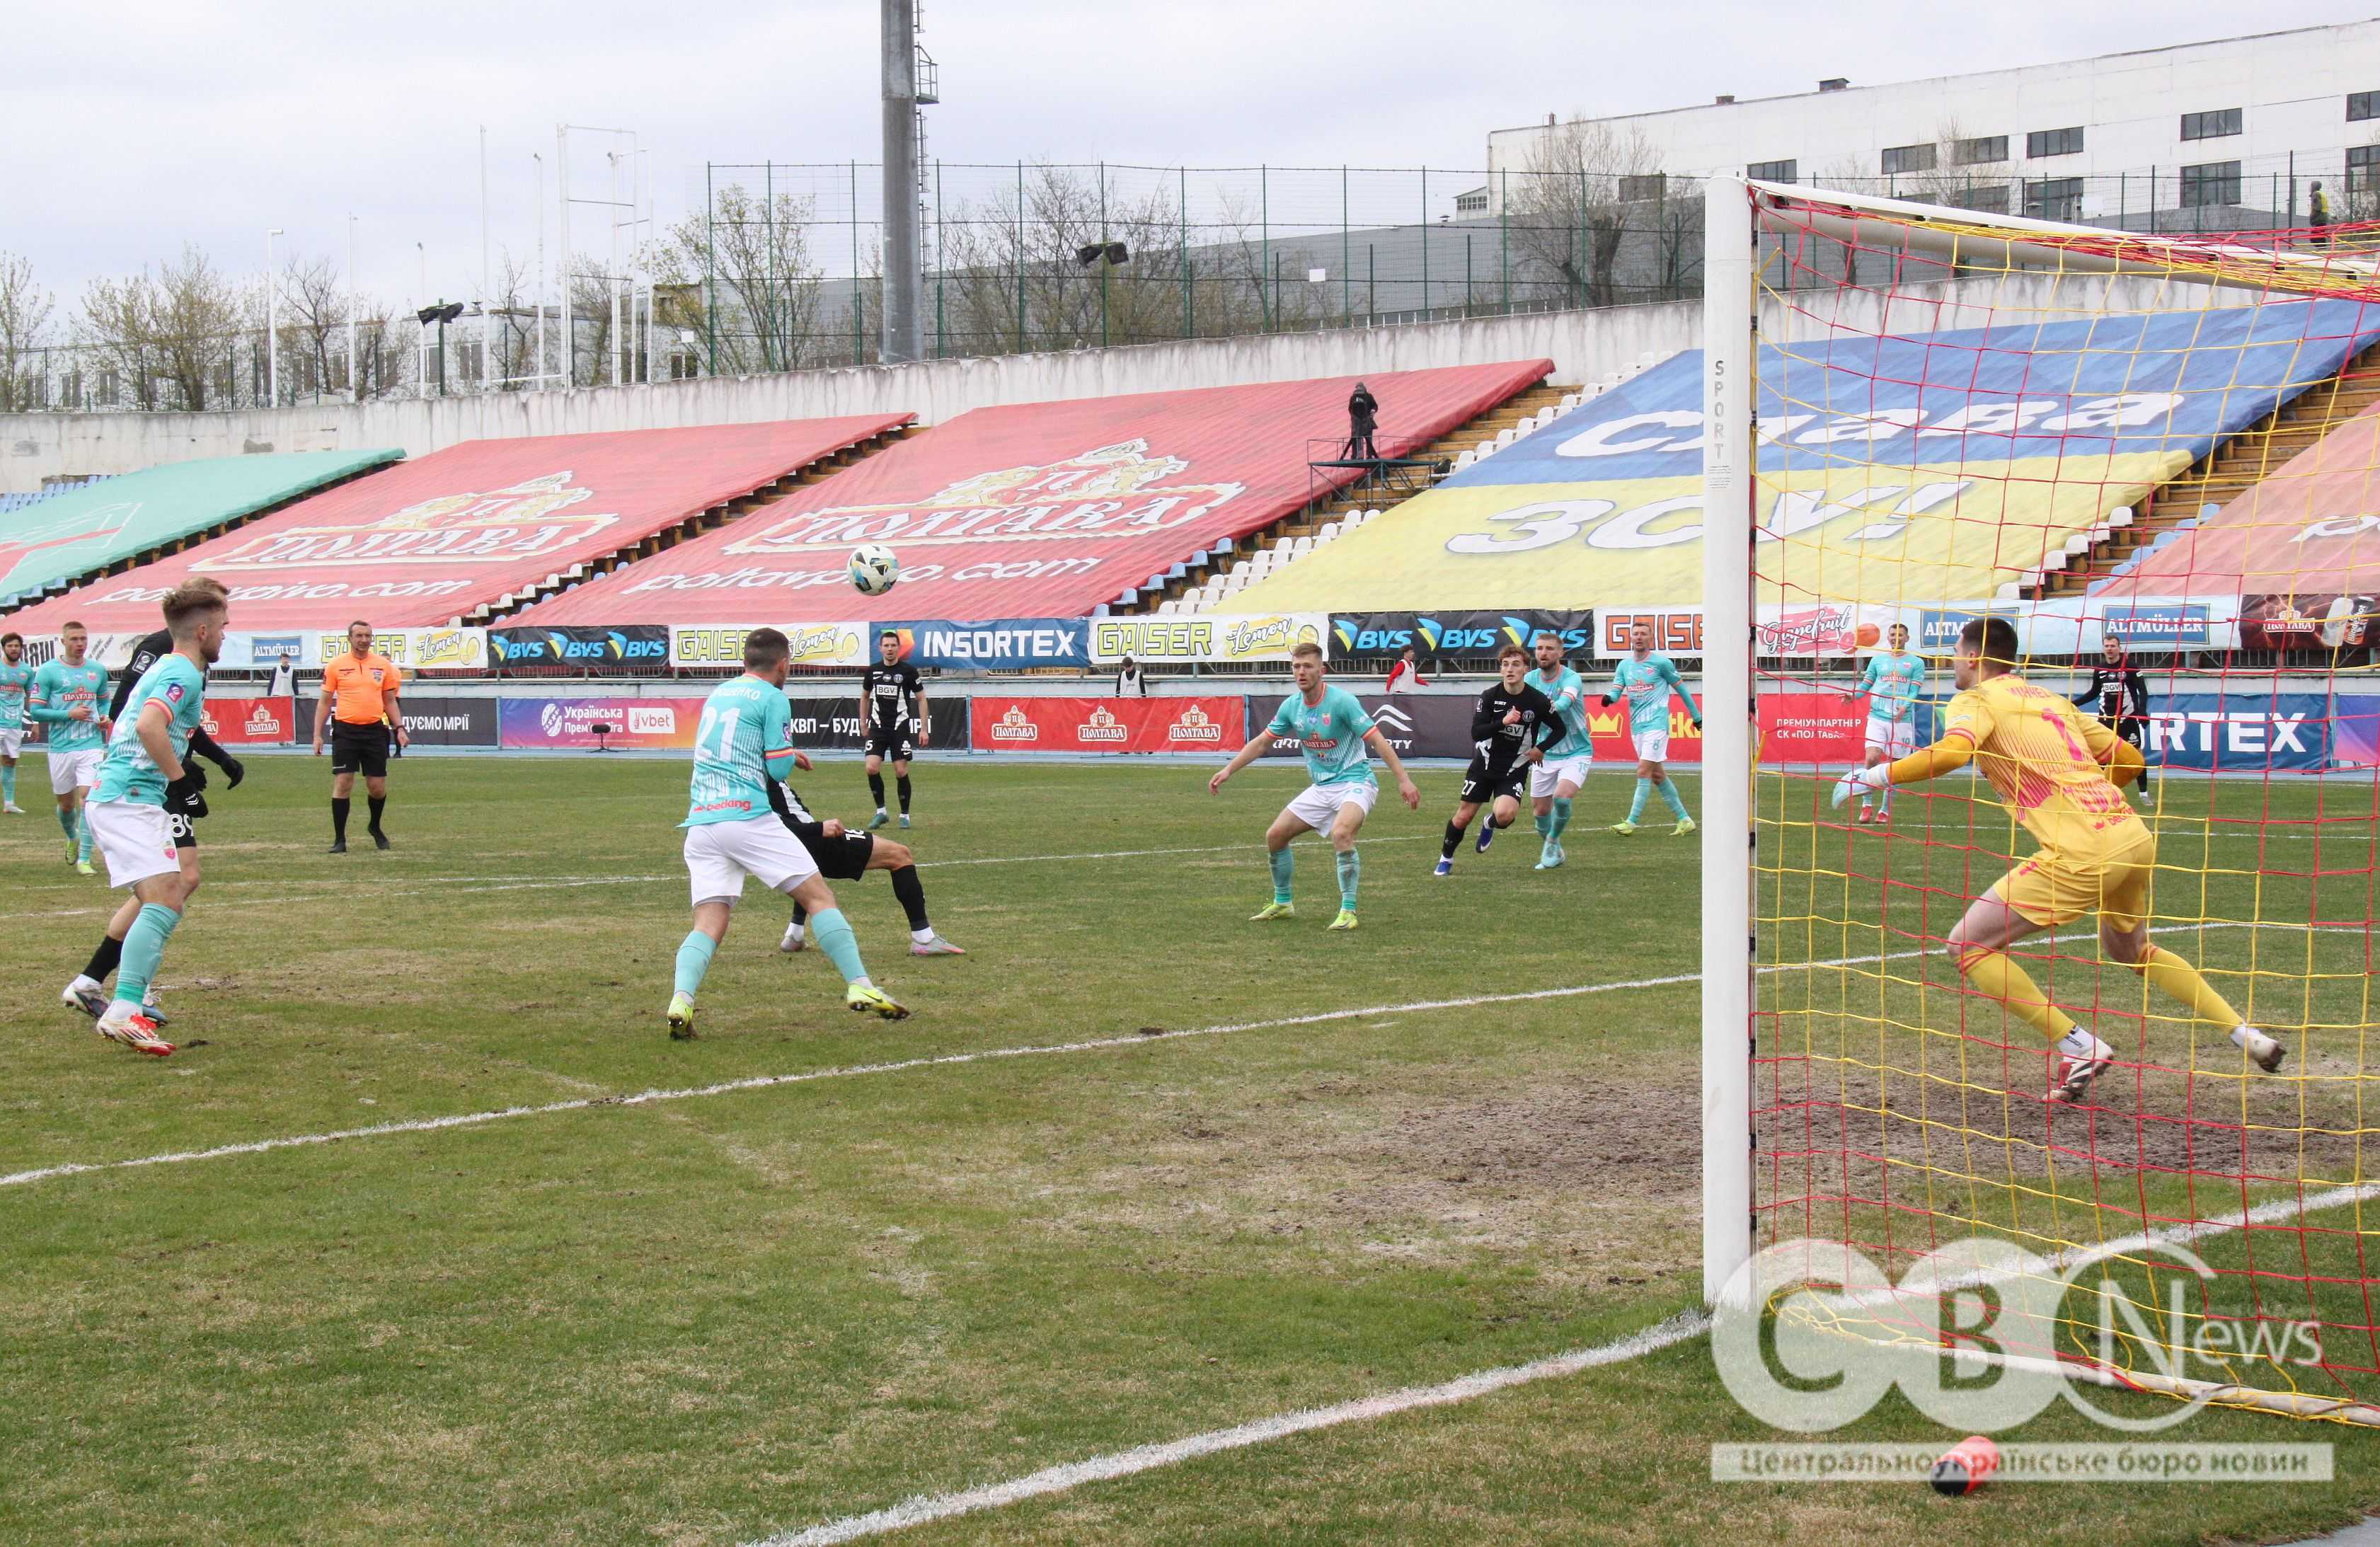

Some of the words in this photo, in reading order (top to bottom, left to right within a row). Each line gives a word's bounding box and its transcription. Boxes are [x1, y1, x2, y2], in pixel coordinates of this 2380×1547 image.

[1714, 360, 1725, 459] SPORT
[1555, 393, 2185, 457] Слава
[764, 496, 1186, 544] ПОЛТАВА
[226, 524, 573, 563] ПОЛТАВА
[621, 558, 1103, 594] poltavpo.com
[1226, 617, 1292, 656] Lemon
[1762, 605, 1852, 654] Grapefruit
[2106, 614, 2204, 634] ALTMÜLLER
[254, 643, 301, 657] ALTMÜLLER
[321, 634, 406, 663] GAER
[417, 631, 463, 662] Lemon
[507, 642, 545, 659] BVS
[565, 641, 606, 657] BVS
[626, 640, 667, 657] BVS
[789, 626, 840, 660] Lemon
[923, 629, 1079, 657] INSORTEX
[1098, 622, 1212, 657] GAISER
[1356, 630, 1414, 649] BVS
[1441, 628, 1498, 648] BVS
[1527, 628, 1587, 648] BS
[403, 715, 442, 732] ДУЄМО
[444, 713, 469, 731] МРІЇ
[564, 705, 623, 720] Українська
[641, 708, 670, 727] vbet
[248, 723, 277, 732] ПОЛТАВА
[695, 706, 740, 762] 21
[996, 728, 1034, 737] ПОЛТАВА
[1081, 728, 1124, 739] ПОЛТАВА
[1172, 728, 1218, 738] ПОЛТАВА
[1505, 725, 1521, 734] GV
[2041, 708, 2083, 761] 1
[1461, 780, 1476, 795] 27
